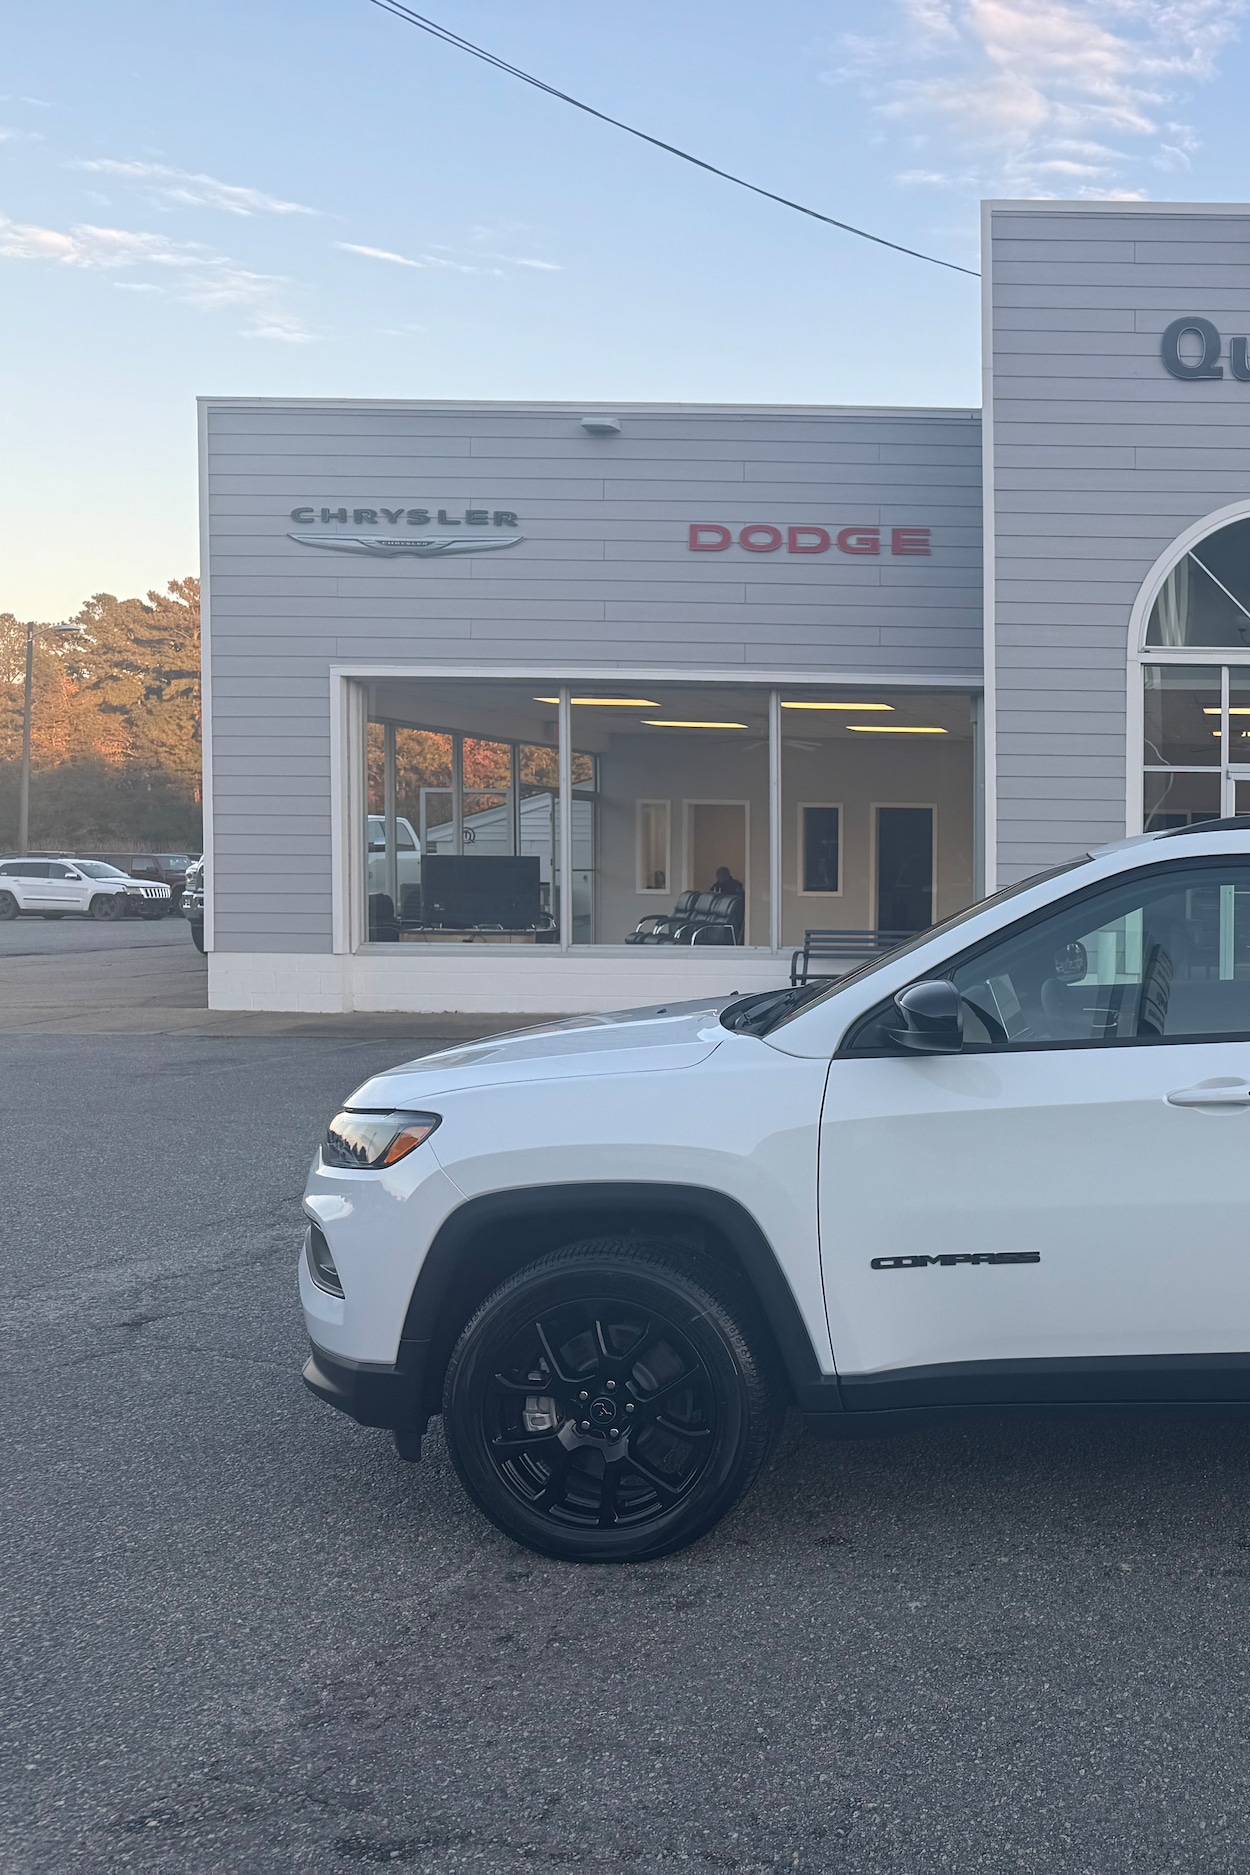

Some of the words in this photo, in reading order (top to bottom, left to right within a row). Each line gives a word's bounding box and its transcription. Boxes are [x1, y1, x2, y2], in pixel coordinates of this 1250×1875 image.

[290, 507, 518, 527] CHRYSLER
[689, 524, 931, 556] DODGE
[871, 1251, 1041, 1270] COMPASS
